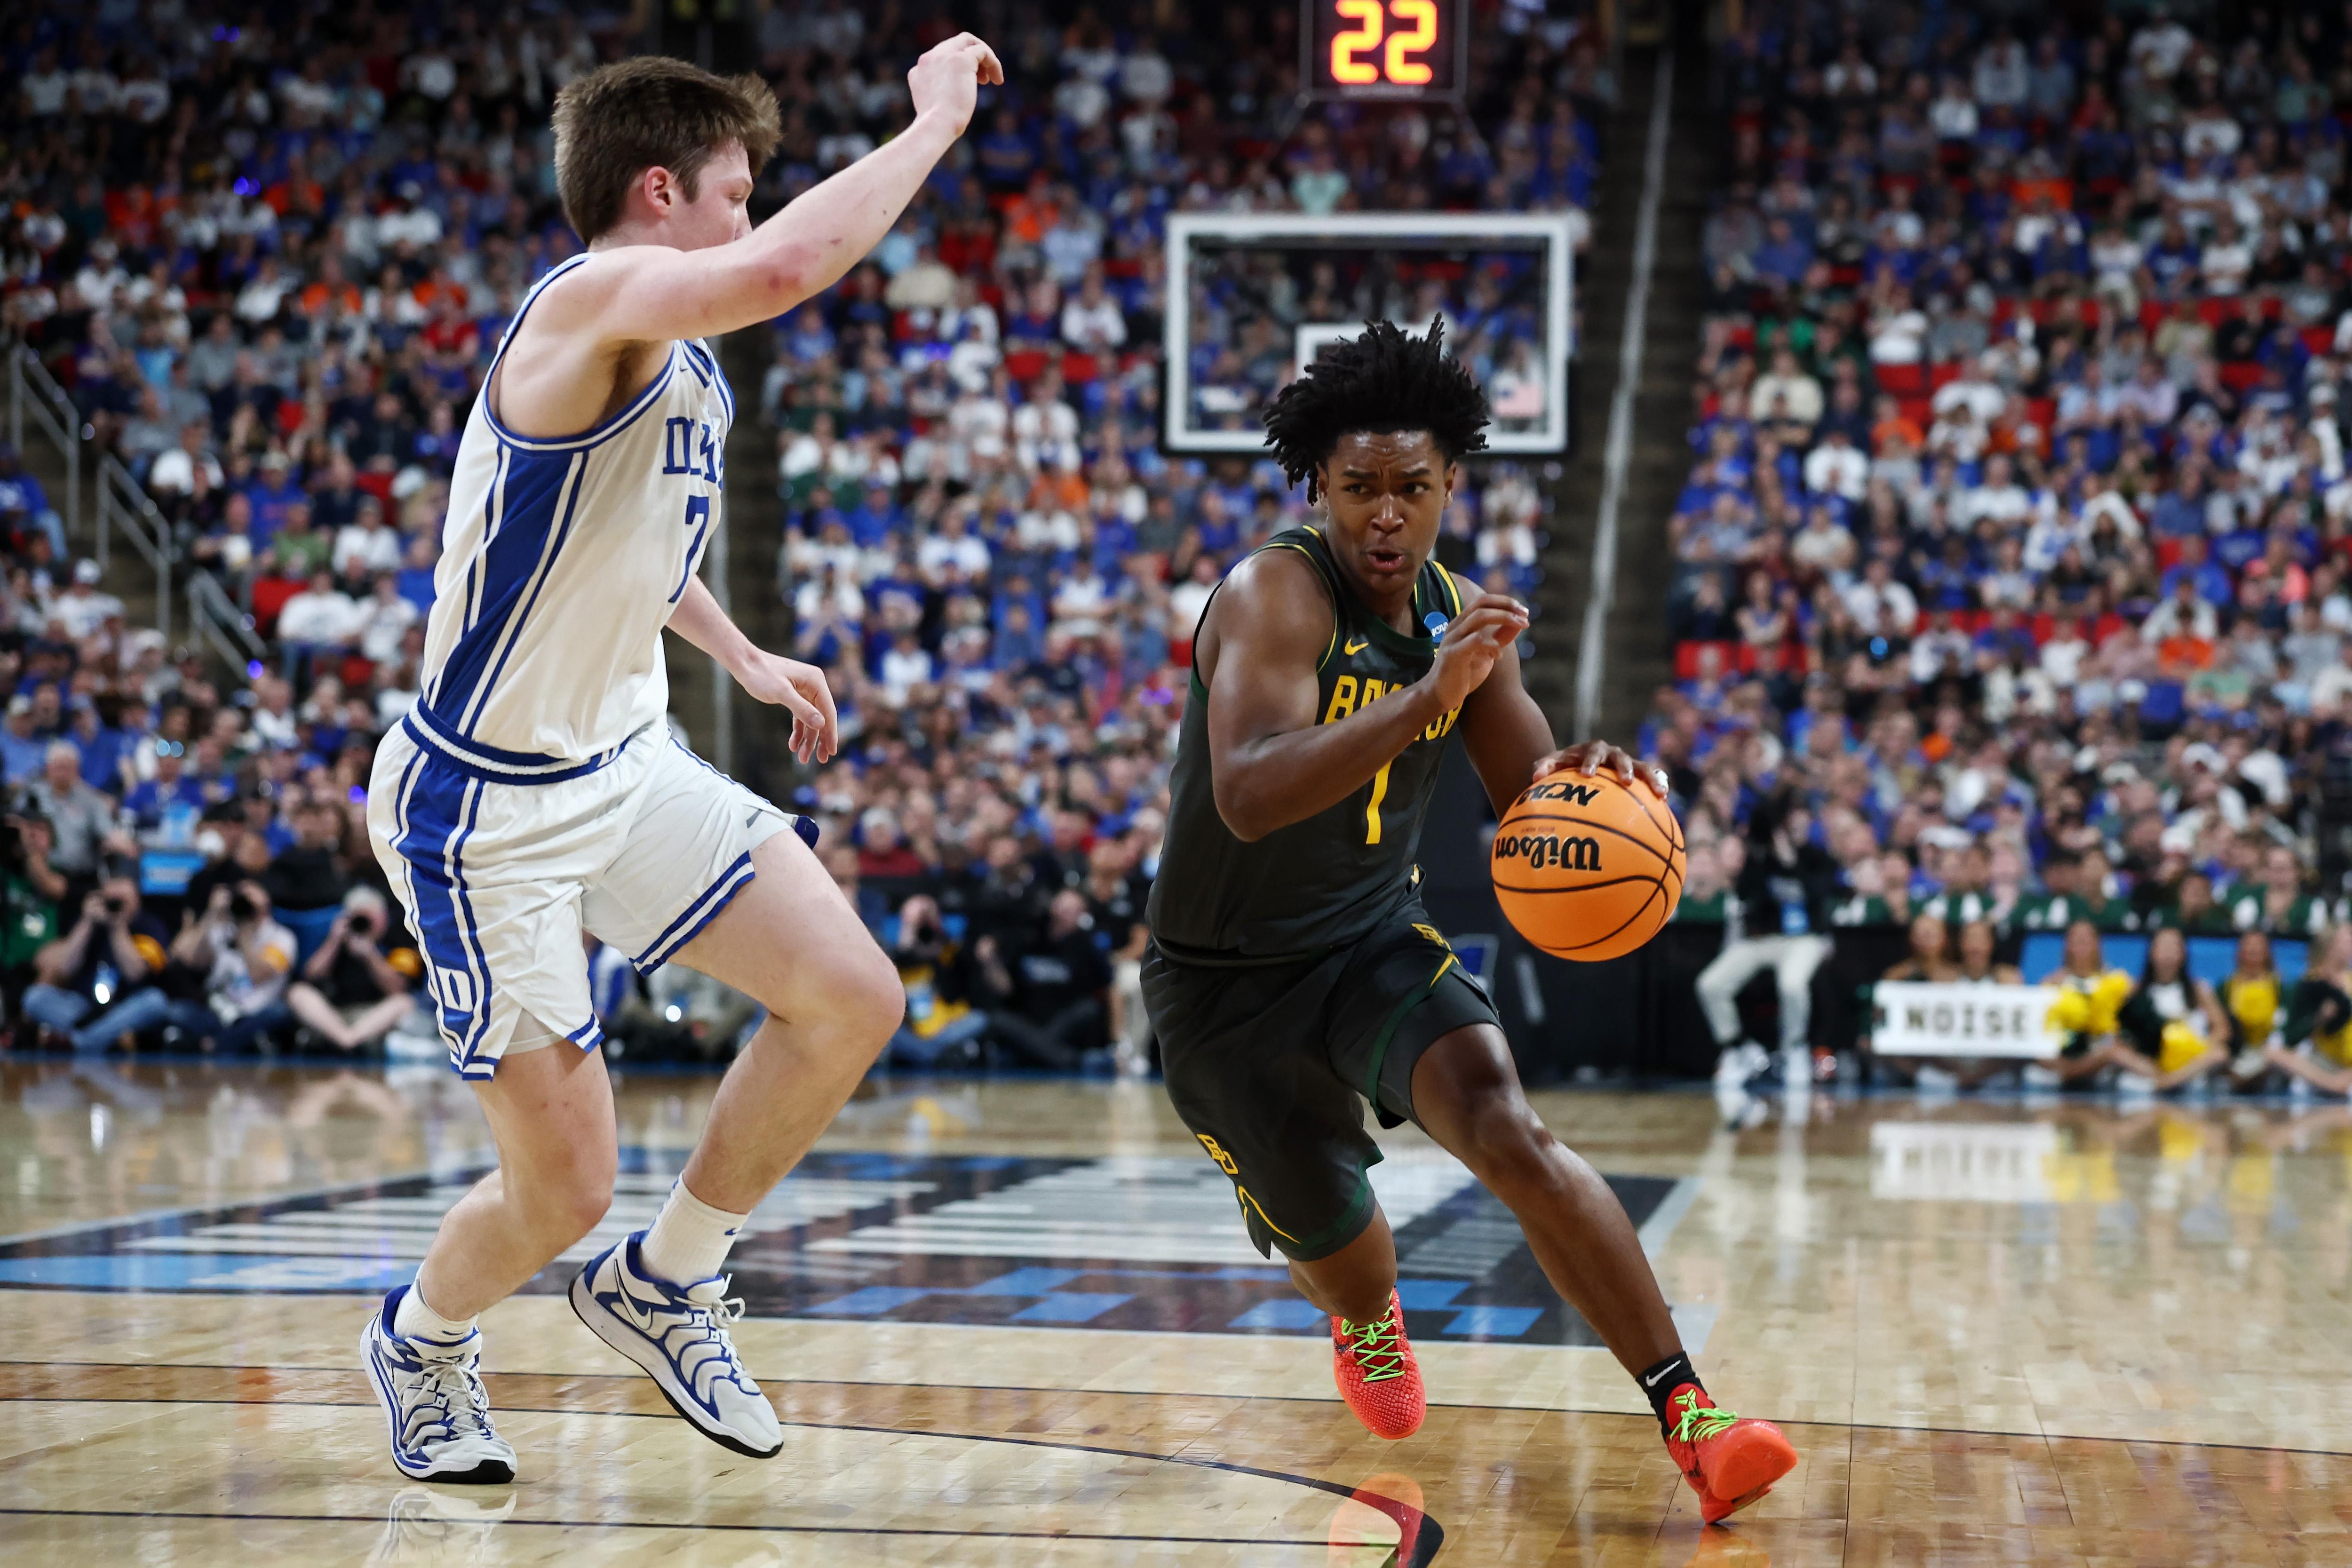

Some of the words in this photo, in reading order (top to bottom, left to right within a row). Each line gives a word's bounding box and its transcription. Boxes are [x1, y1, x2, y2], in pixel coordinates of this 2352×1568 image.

[1330, 0, 1438, 85] 22
[668, 494, 709, 603] 7
[1495, 836, 1603, 871] Wilson
[436, 965, 473, 1013] D
[1906, 1003, 2028, 1036] NOISE
